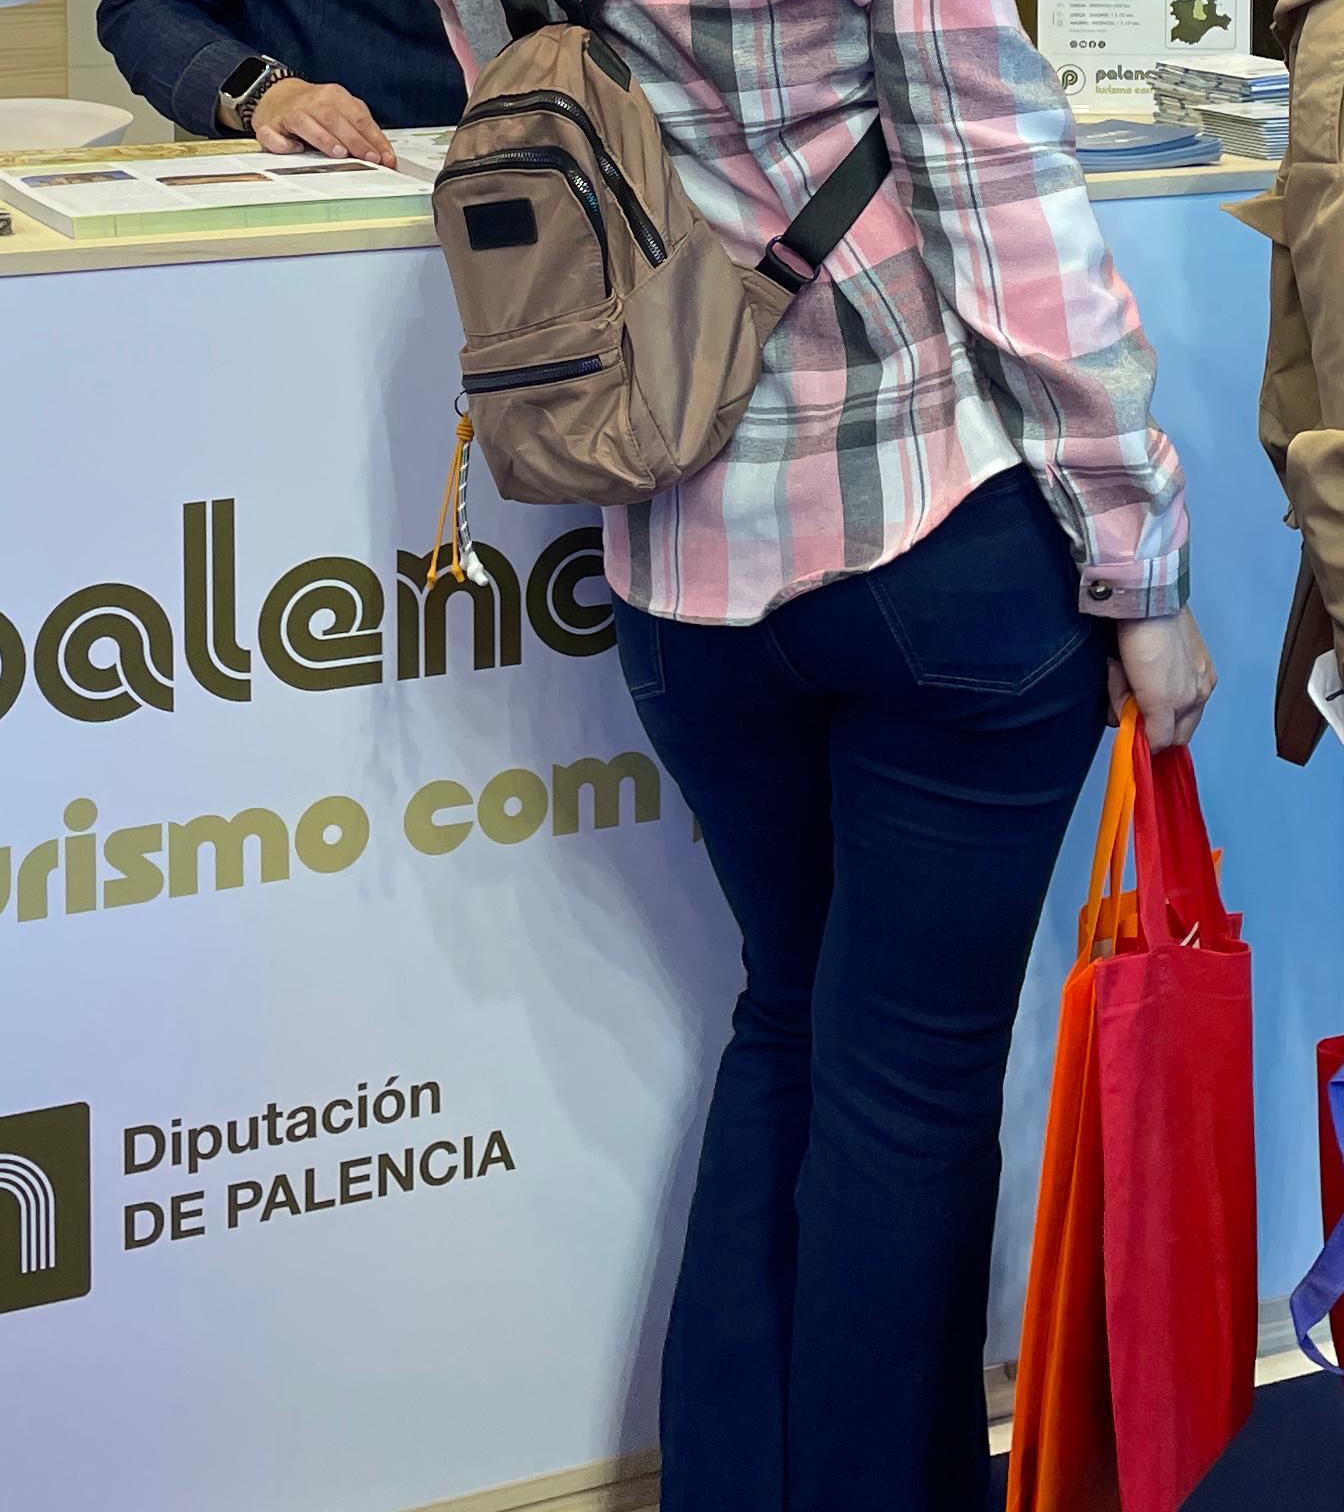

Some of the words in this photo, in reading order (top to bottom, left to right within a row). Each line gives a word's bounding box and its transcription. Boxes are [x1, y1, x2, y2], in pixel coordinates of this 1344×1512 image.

[403, 751, 661, 856] com
[124, 1075, 441, 1175] Diputación
[124, 1190, 205, 1251] DE
[227, 1129, 516, 1230] PALENCIA
